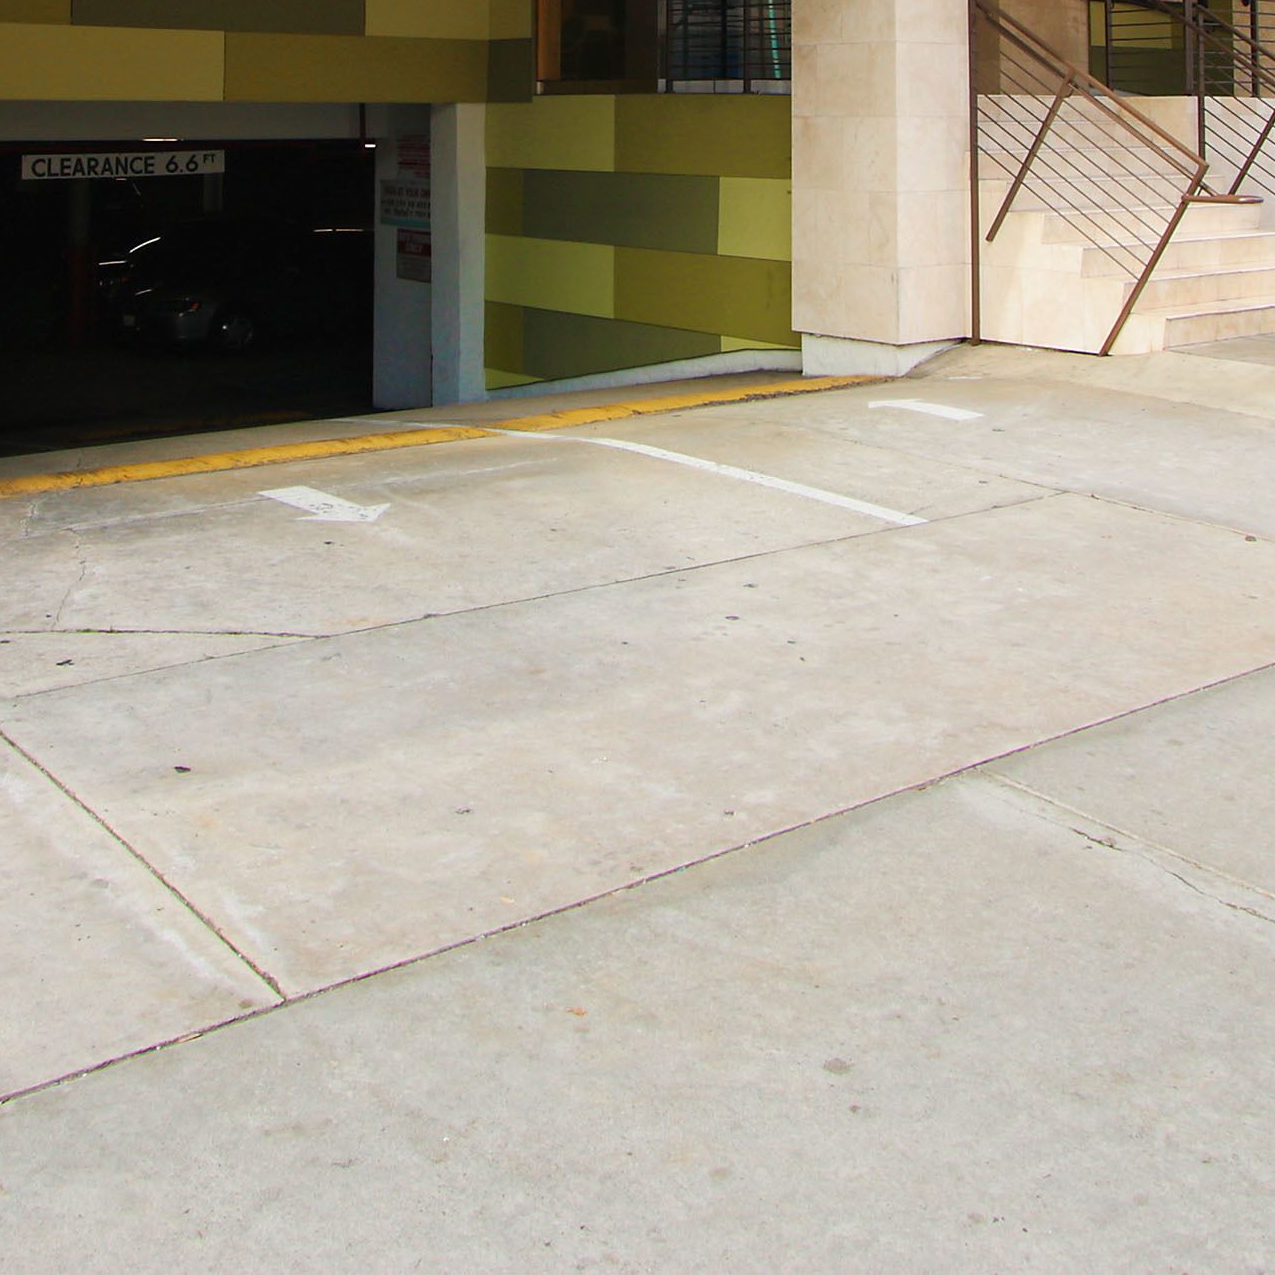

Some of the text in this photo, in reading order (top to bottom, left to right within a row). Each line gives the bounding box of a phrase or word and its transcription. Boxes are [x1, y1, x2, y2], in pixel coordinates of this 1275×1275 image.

[31, 153, 217, 179] CLEARANCE 6.6 FT
